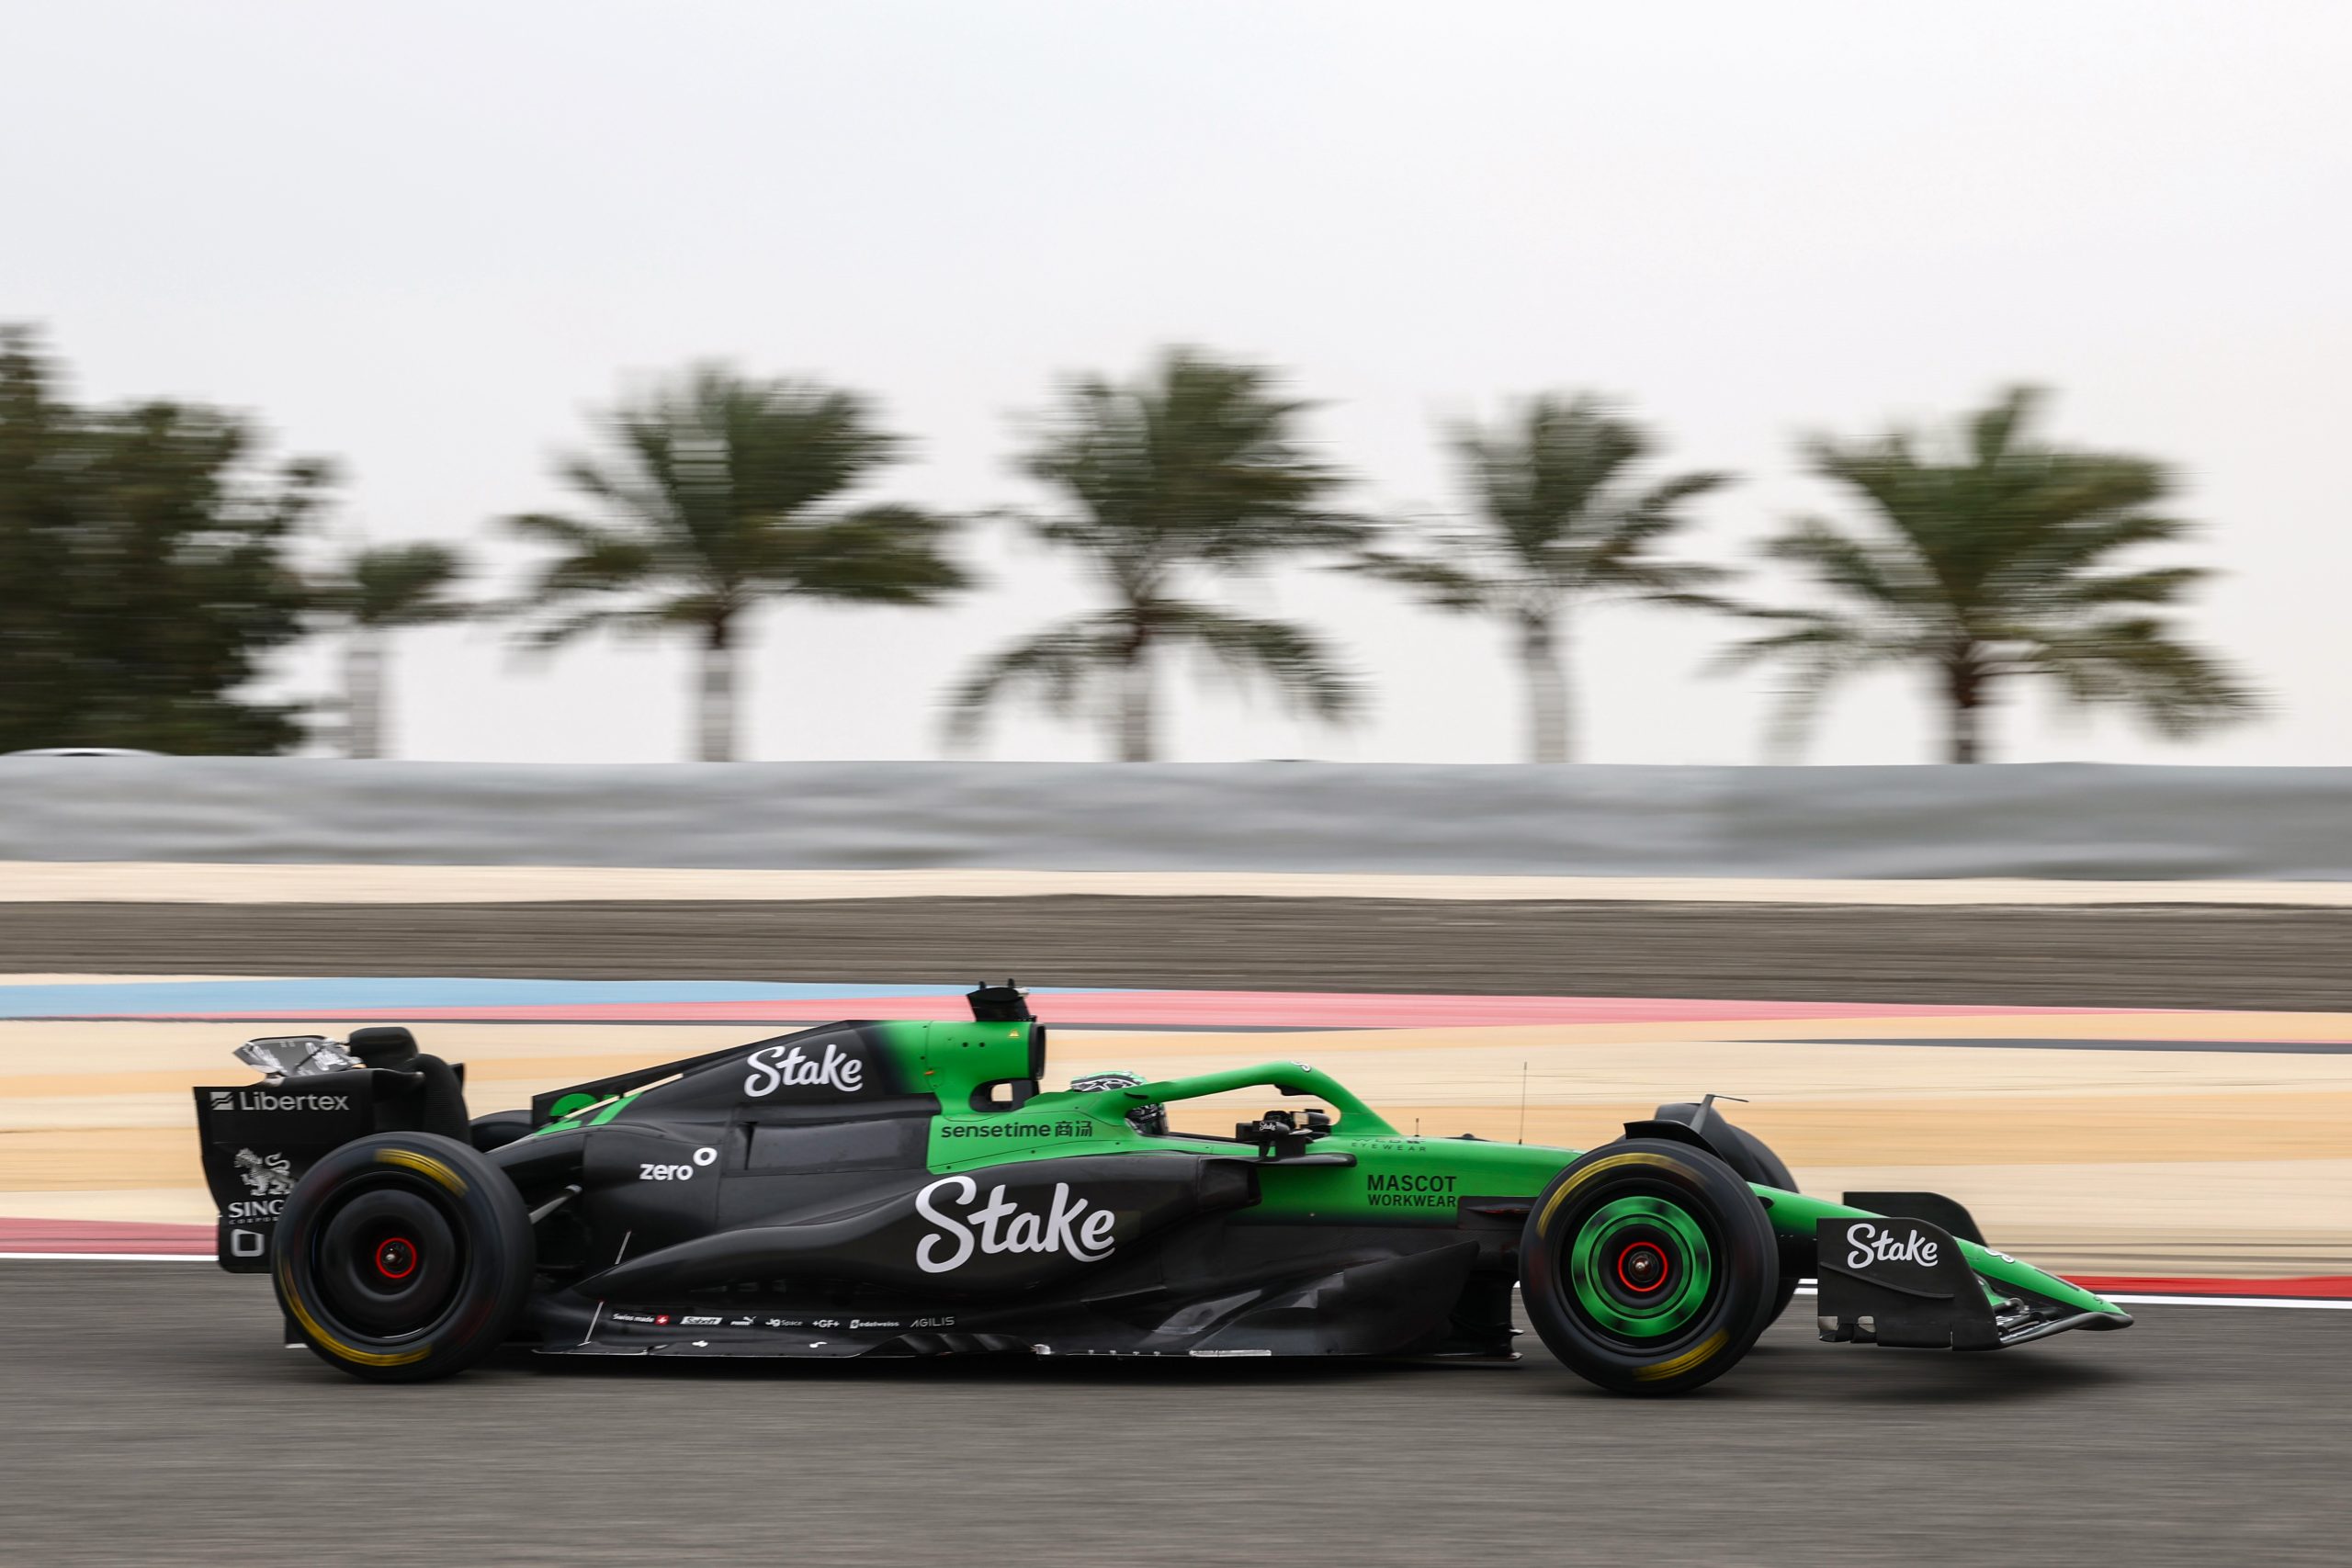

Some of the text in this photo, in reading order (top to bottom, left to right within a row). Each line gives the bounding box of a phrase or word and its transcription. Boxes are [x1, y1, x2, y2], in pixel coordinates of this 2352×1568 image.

[744, 1044, 863, 1097] Stake
[240, 1091, 350, 1111] Libertex
[941, 1121, 1092, 1138] sensetime 商汤
[1351, 1142, 1426, 1152] EYEWEAR
[1367, 1174, 1457, 1192] MASCOT
[1367, 1194, 1456, 1207] WORKWEAR
[916, 1175, 1115, 1273] Stake
[1846, 1224, 1939, 1269] Stake
